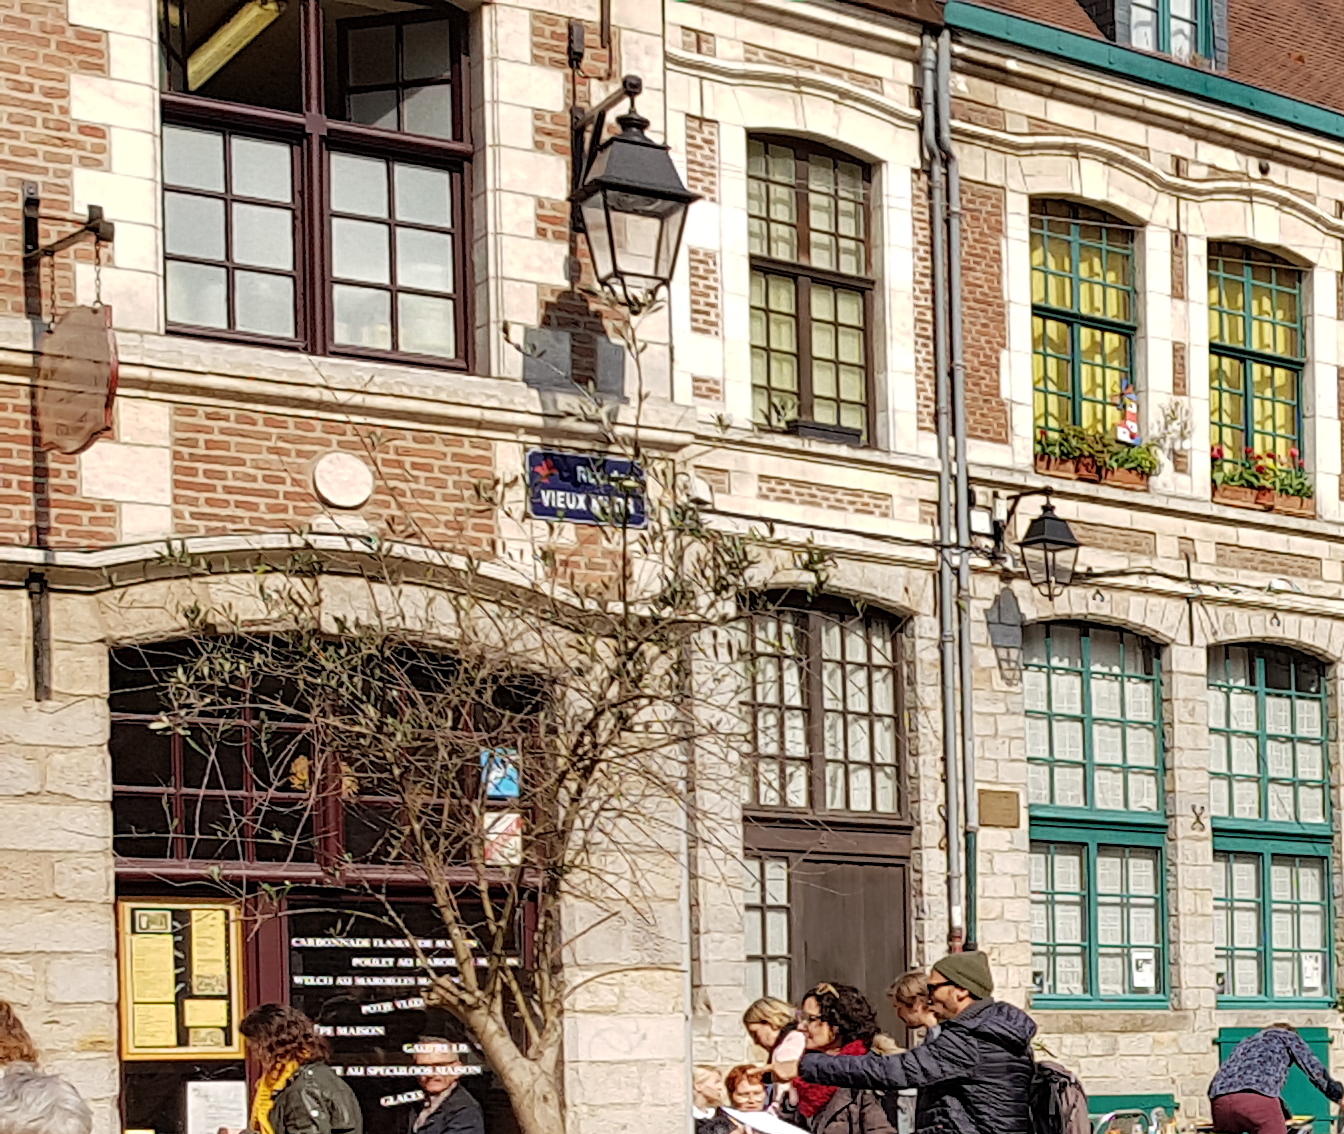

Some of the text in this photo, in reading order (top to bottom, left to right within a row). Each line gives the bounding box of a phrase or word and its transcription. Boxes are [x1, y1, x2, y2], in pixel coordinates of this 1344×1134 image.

[540, 489, 587, 511] VIEUX
[291, 937, 371, 948] CARBONNADE
[351, 957, 394, 967] POULET
[293, 976, 333, 986] WELCH
[336, 1026, 385, 1036] MAISON
[366, 1065, 433, 1076] SPECULOOS
[436, 1065, 482, 1076] MAISON
